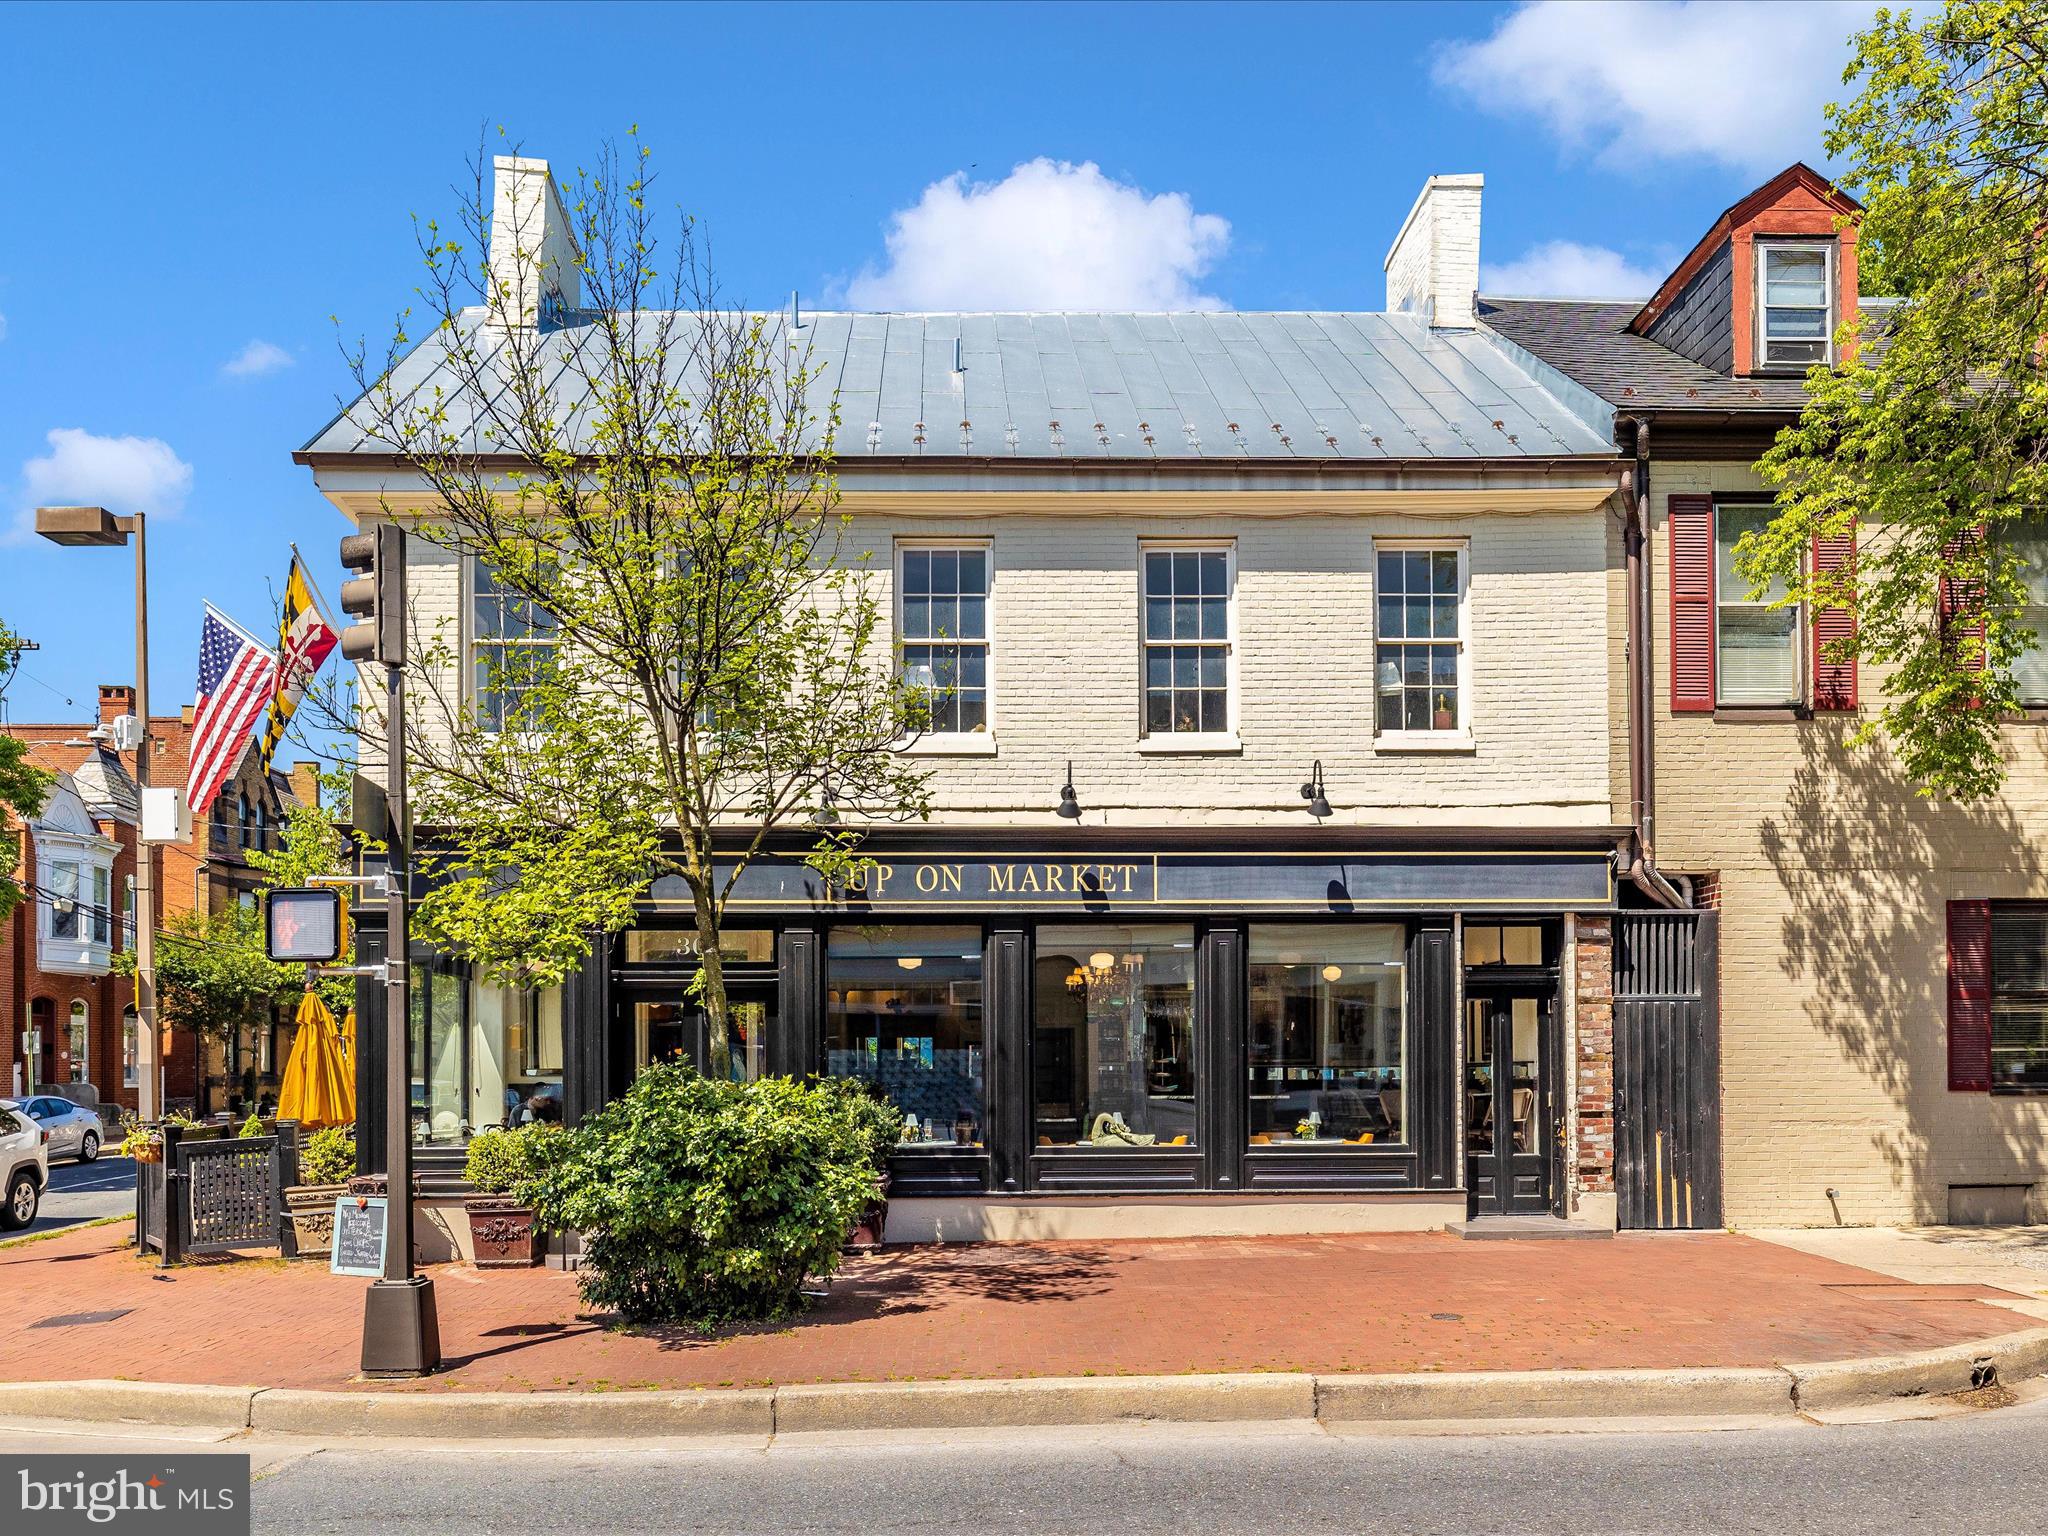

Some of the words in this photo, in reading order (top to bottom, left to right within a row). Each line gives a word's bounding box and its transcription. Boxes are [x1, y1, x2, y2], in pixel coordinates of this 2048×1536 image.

[847, 864, 893, 892] UP
[916, 864, 965, 892] ON
[988, 864, 1138, 892] MARKET
